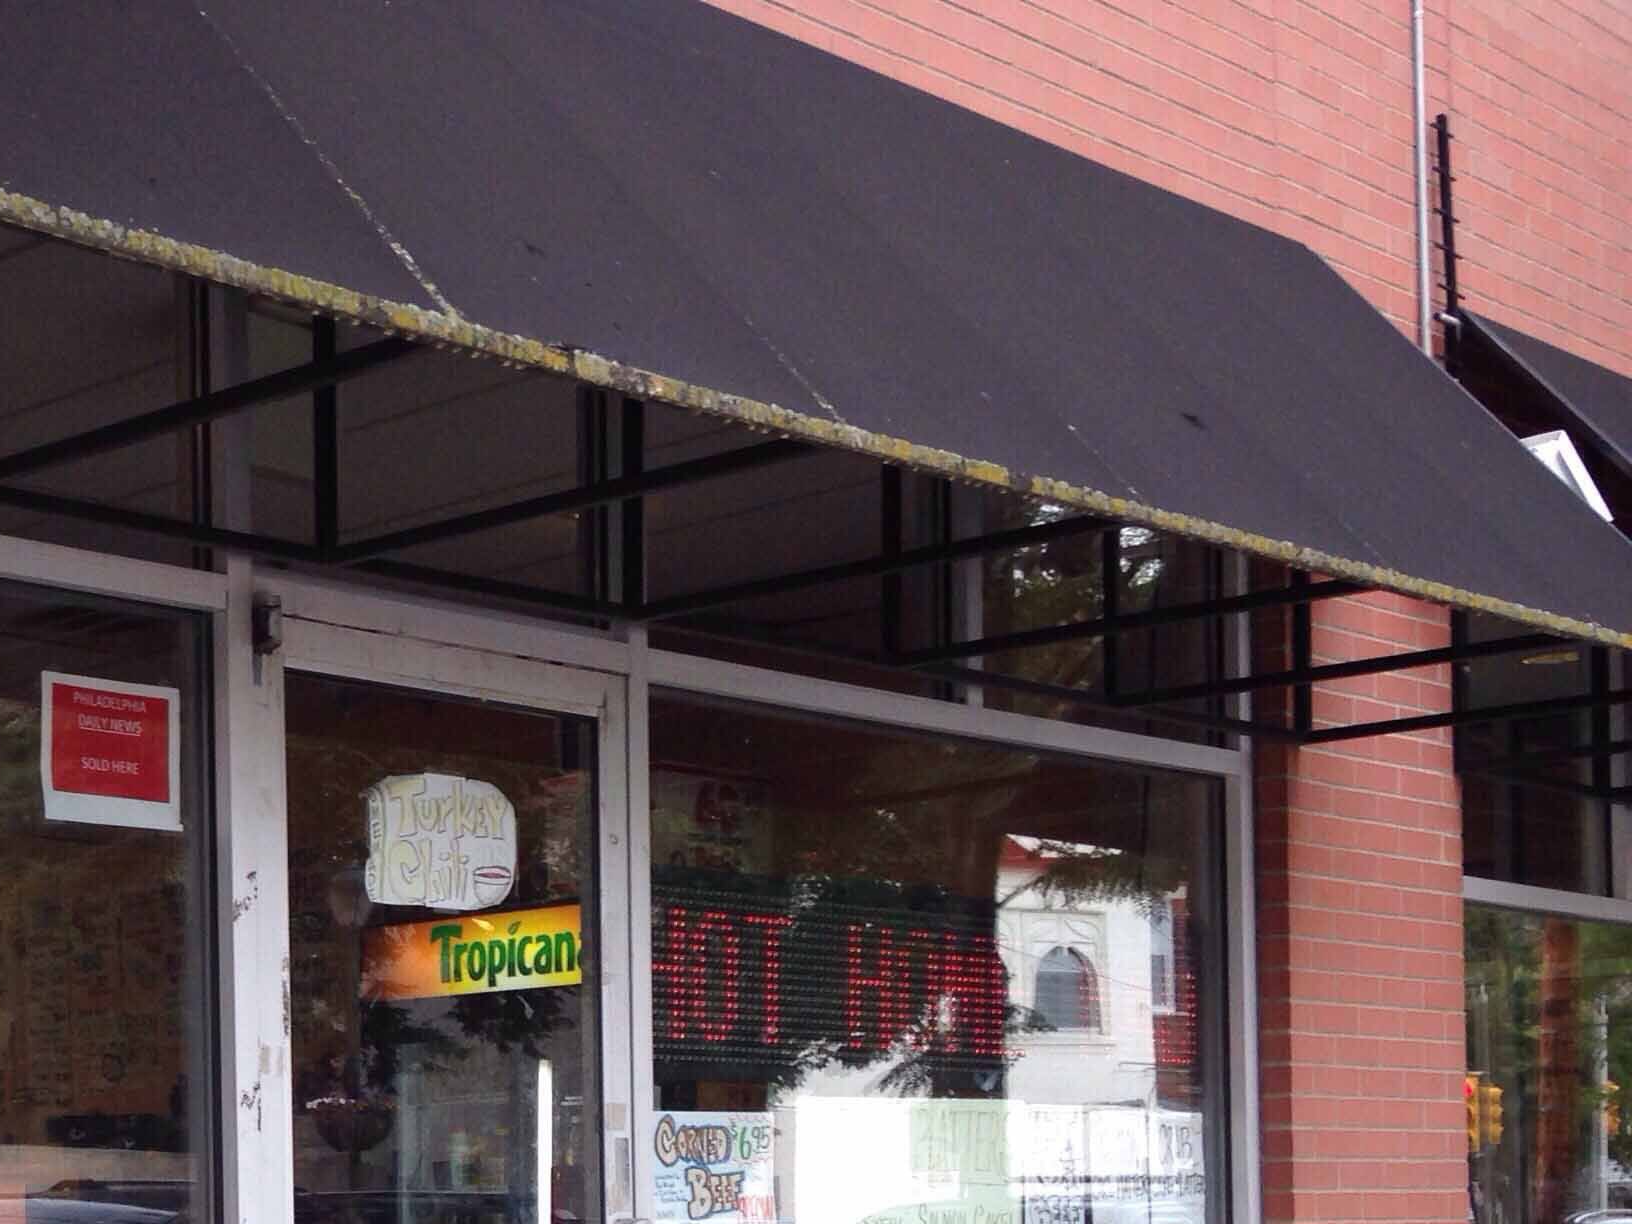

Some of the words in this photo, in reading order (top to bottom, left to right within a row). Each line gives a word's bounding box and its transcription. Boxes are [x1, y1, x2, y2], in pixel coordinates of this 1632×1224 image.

[73, 691, 147, 713] PHILADELPHIA
[78, 714, 109, 731] DAILY
[110, 718, 143, 734] NEWS
[81, 756, 110, 772] SOLD
[112, 759, 140, 775] HERE
[430, 920, 582, 988] Tropican
[684, 1165, 746, 1221] BEEF
